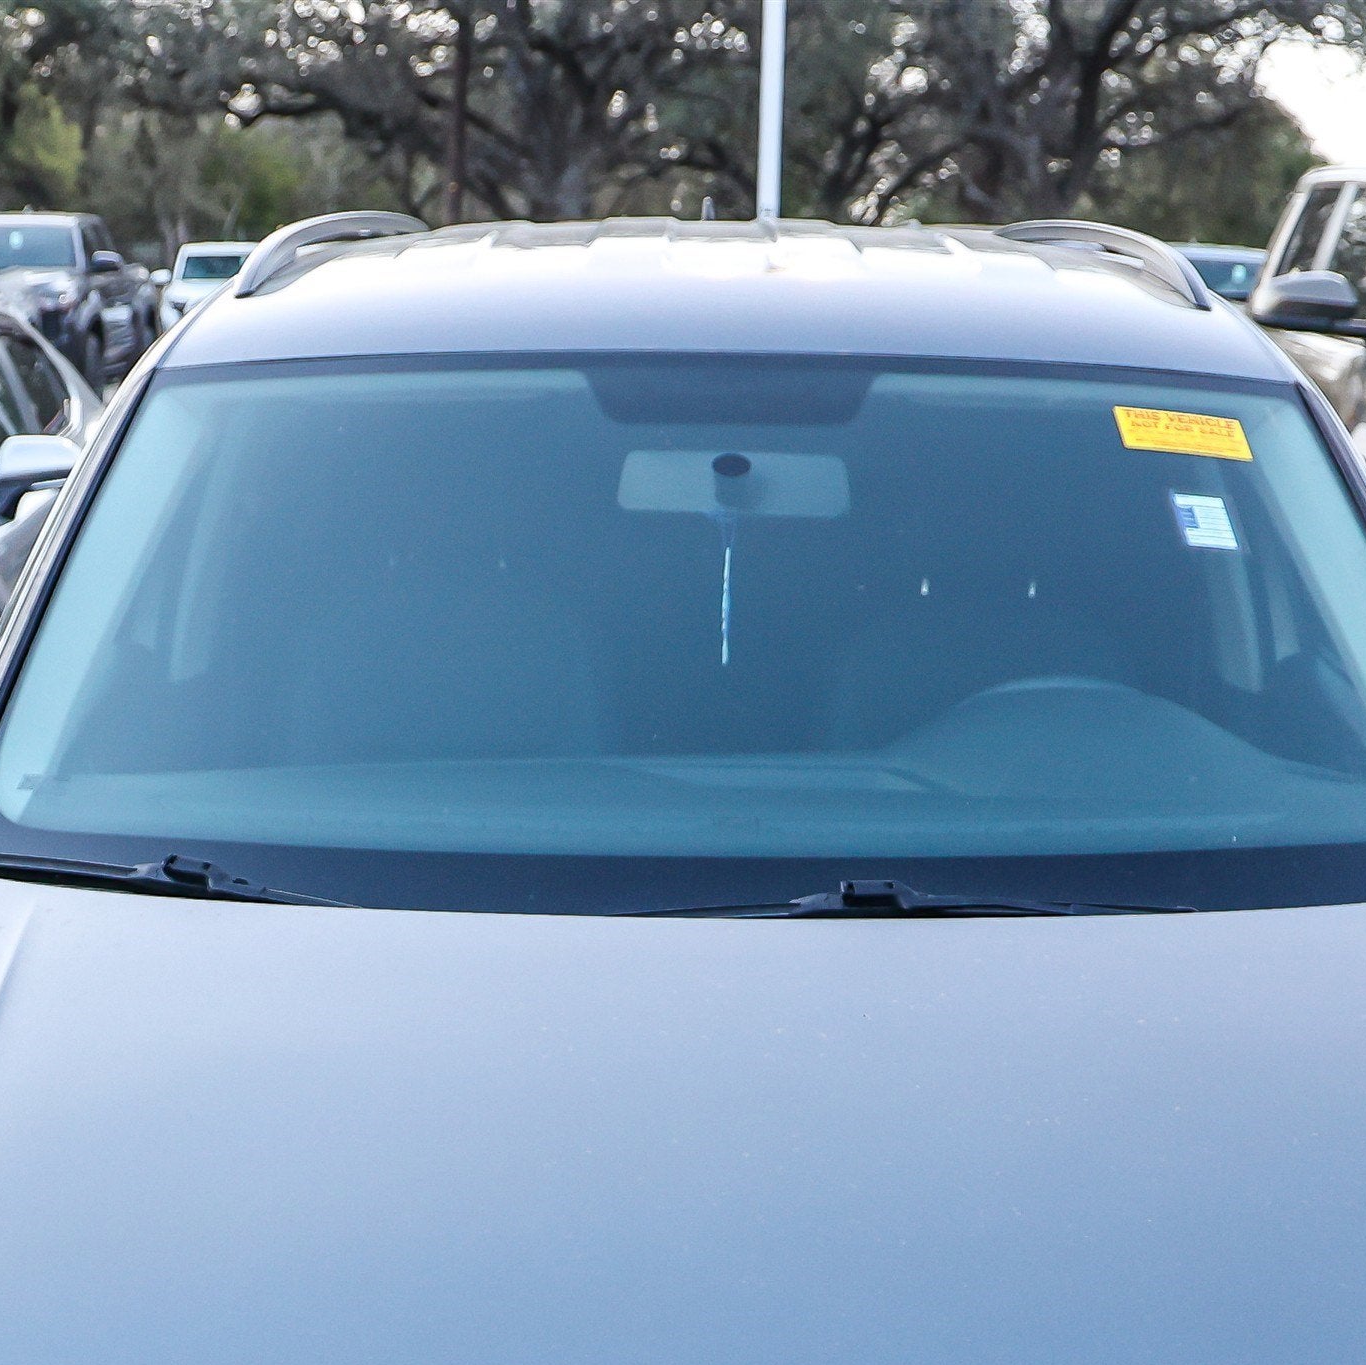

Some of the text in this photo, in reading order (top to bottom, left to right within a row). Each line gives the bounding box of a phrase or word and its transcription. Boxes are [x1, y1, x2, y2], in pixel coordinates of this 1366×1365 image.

[1123, 409, 1235, 430] THIS VEHICLE
[1131, 420, 1235, 438] NOT FOR SALE
